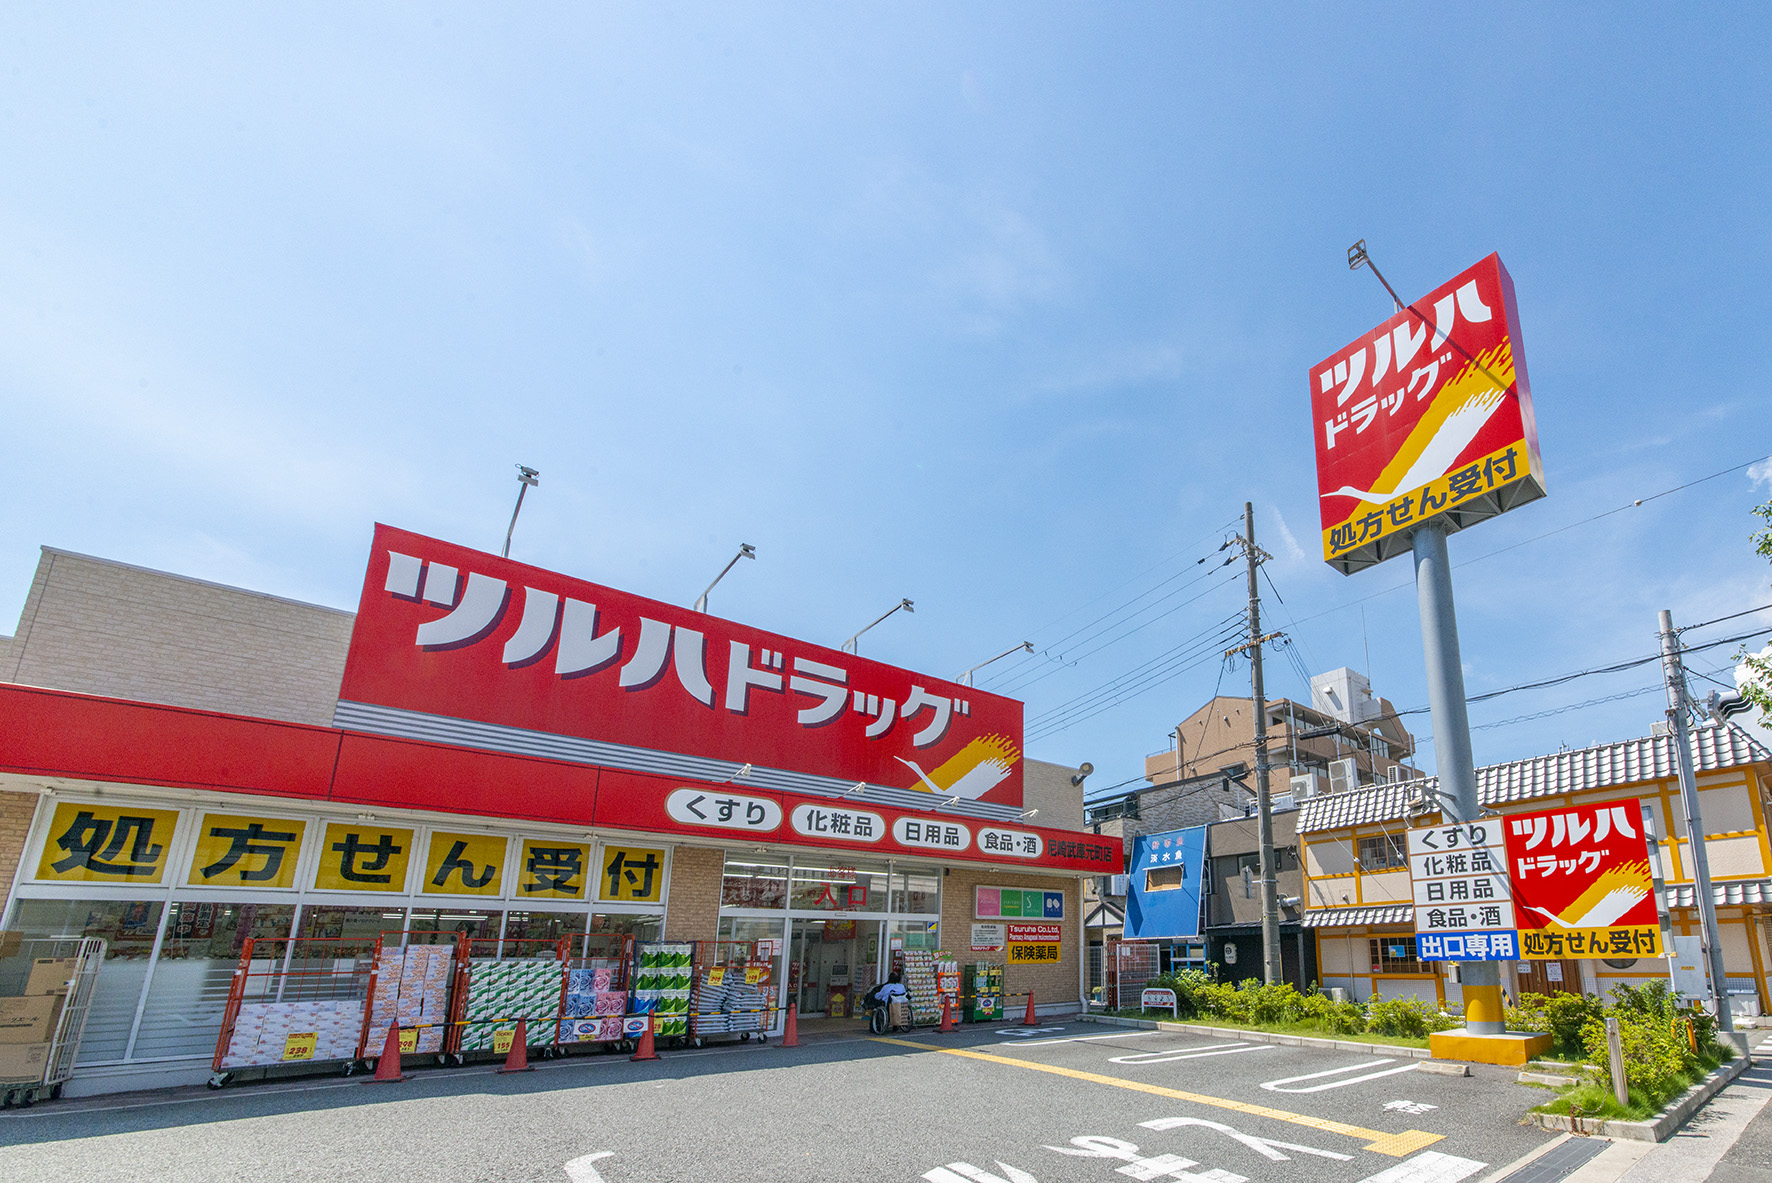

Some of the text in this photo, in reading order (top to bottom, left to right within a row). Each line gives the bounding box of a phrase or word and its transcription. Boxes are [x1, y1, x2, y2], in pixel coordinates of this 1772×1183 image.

[1319, 279, 1492, 407] ツルハ
[1325, 352, 1452, 450] ドラッグ
[1329, 447, 1517, 554] 処方せん受付
[384, 550, 970, 747] ツルハドラッグ
[686, 795, 766, 825] くすり
[806, 809, 873, 838] 化粧品
[905, 822, 959, 846] 日用品
[1421, 824, 1487, 850] くすり
[1511, 806, 1636, 850] ツルハ
[51, 811, 660, 897] 処方せん受付
[984, 831, 1037, 855] 食品・酒
[1424, 851, 1492, 876] 化粧品
[1517, 849, 1610, 880] ドラッグ
[814, 883, 867, 906] 入口
[1426, 878, 1494, 902] 日用品
[1427, 906, 1501, 929] 食品・酒
[1011, 945, 1058, 960] 保険薬局
[1421, 933, 1514, 958] 出口専用
[1523, 928, 1656, 956] 処方せん受付
